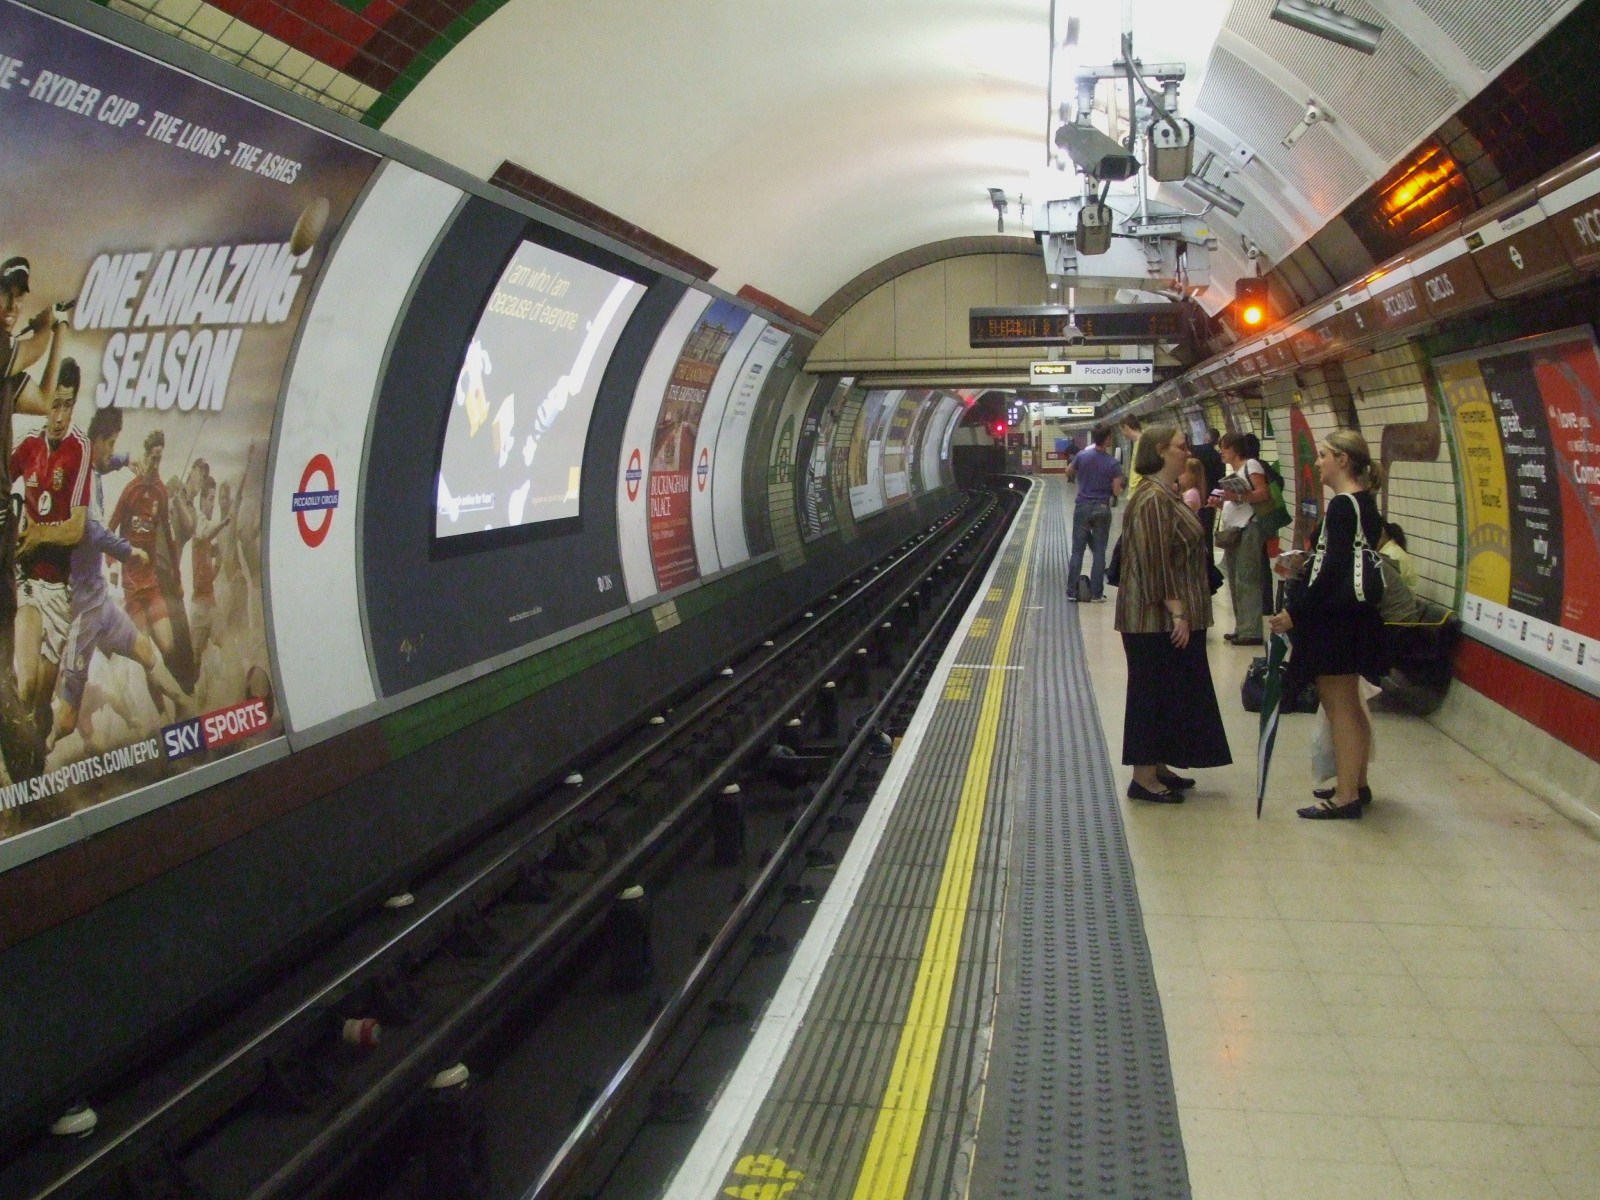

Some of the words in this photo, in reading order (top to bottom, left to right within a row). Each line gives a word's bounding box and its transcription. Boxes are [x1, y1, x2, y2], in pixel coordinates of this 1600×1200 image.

[29, 70, 101, 116] RYDER
[98, 95, 140, 127] CUP
[145, 111, 183, 144] THE
[176, 123, 227, 159] LIONS
[230, 142, 262, 171] THE
[255, 152, 302, 184] ASHES
[73, 252, 153, 331] ONE
[133, 242, 314, 327] AMAZING
[508, 265, 531, 287] am
[526, 267, 551, 292] who
[550, 278, 571, 298] am
[1382, 288, 1417, 318] PICCADILLY
[1425, 273, 1455, 302] CIRCUS
[489, 287, 532, 319] because
[529, 298, 548, 321] of
[539, 304, 579, 332] everyone
[95, 328, 243, 412] SEASON
[1084, 366, 1123, 375] Piccadilly
[1126, 366, 1142, 374] line
[294, 496, 320, 507] PICCADILLY
[321, 494, 338, 505] CIRCUS
[650, 497, 671, 518] PALACE
[651, 474, 689, 496] BUCKINGHAM
[164, 722, 201, 758] SKY
[204, 701, 268, 744] SPORTS
[0, 738, 160, 812] WW.SKYSPORTS.COM/EPIC
